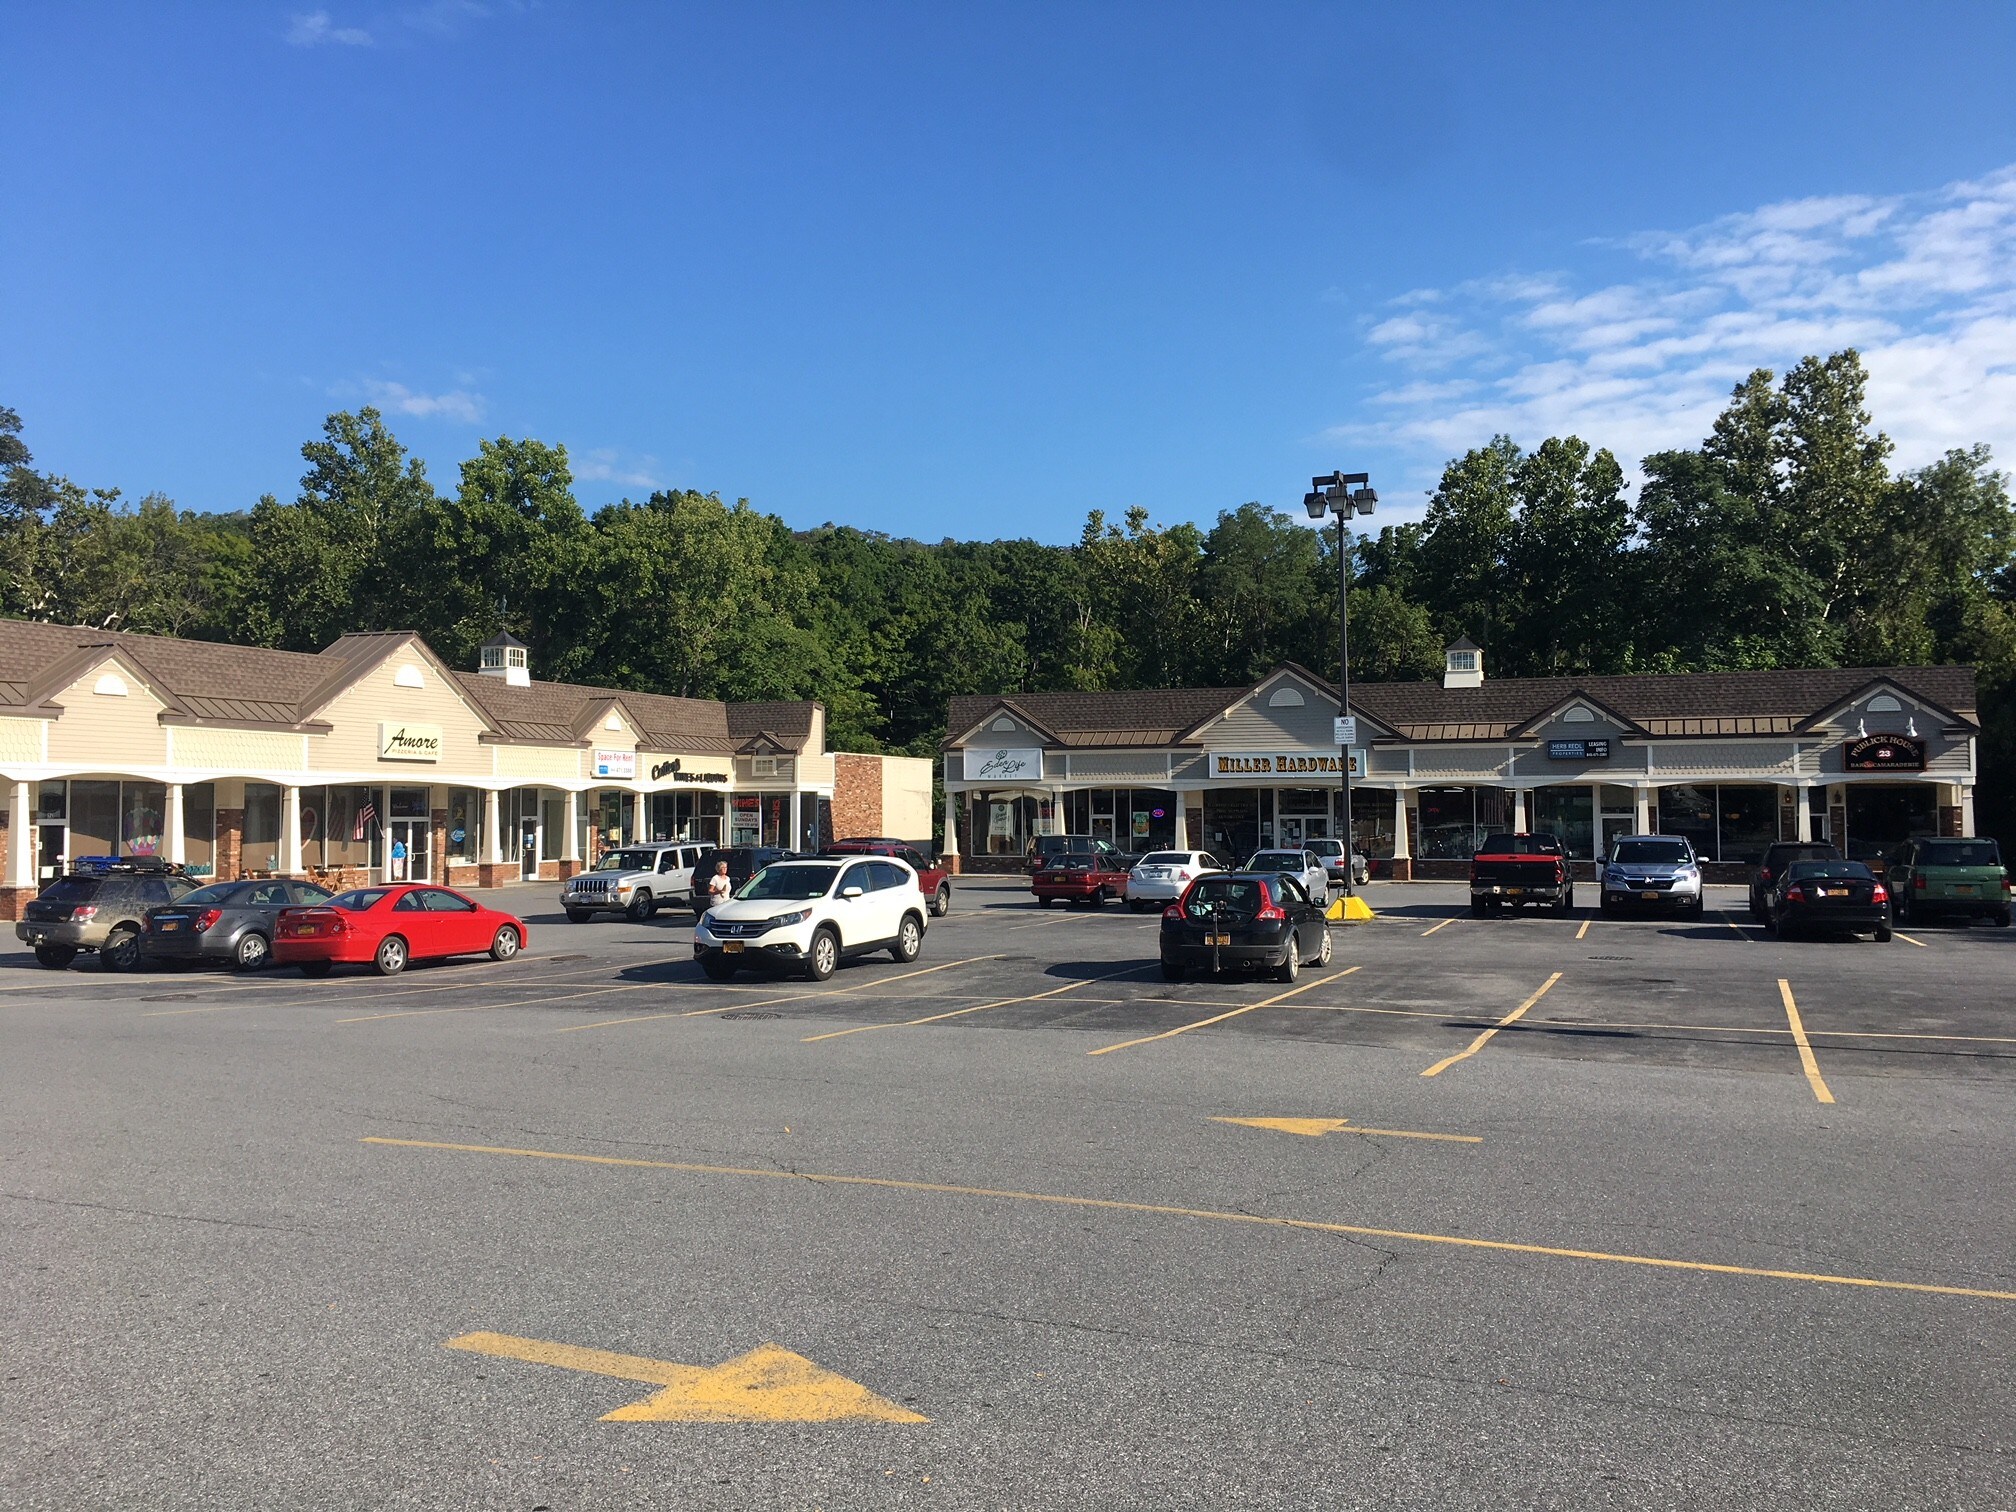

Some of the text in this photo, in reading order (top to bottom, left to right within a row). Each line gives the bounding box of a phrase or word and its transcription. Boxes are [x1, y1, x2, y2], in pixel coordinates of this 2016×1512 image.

[384, 728, 438, 754] Amore
[1851, 736, 1919, 757] PUBLICK HOUSE
[598, 752, 612, 761] Space
[613, 753, 621, 761] For
[1217, 756, 1271, 773] MILLER
[980, 760, 1026, 777] Eden Life
